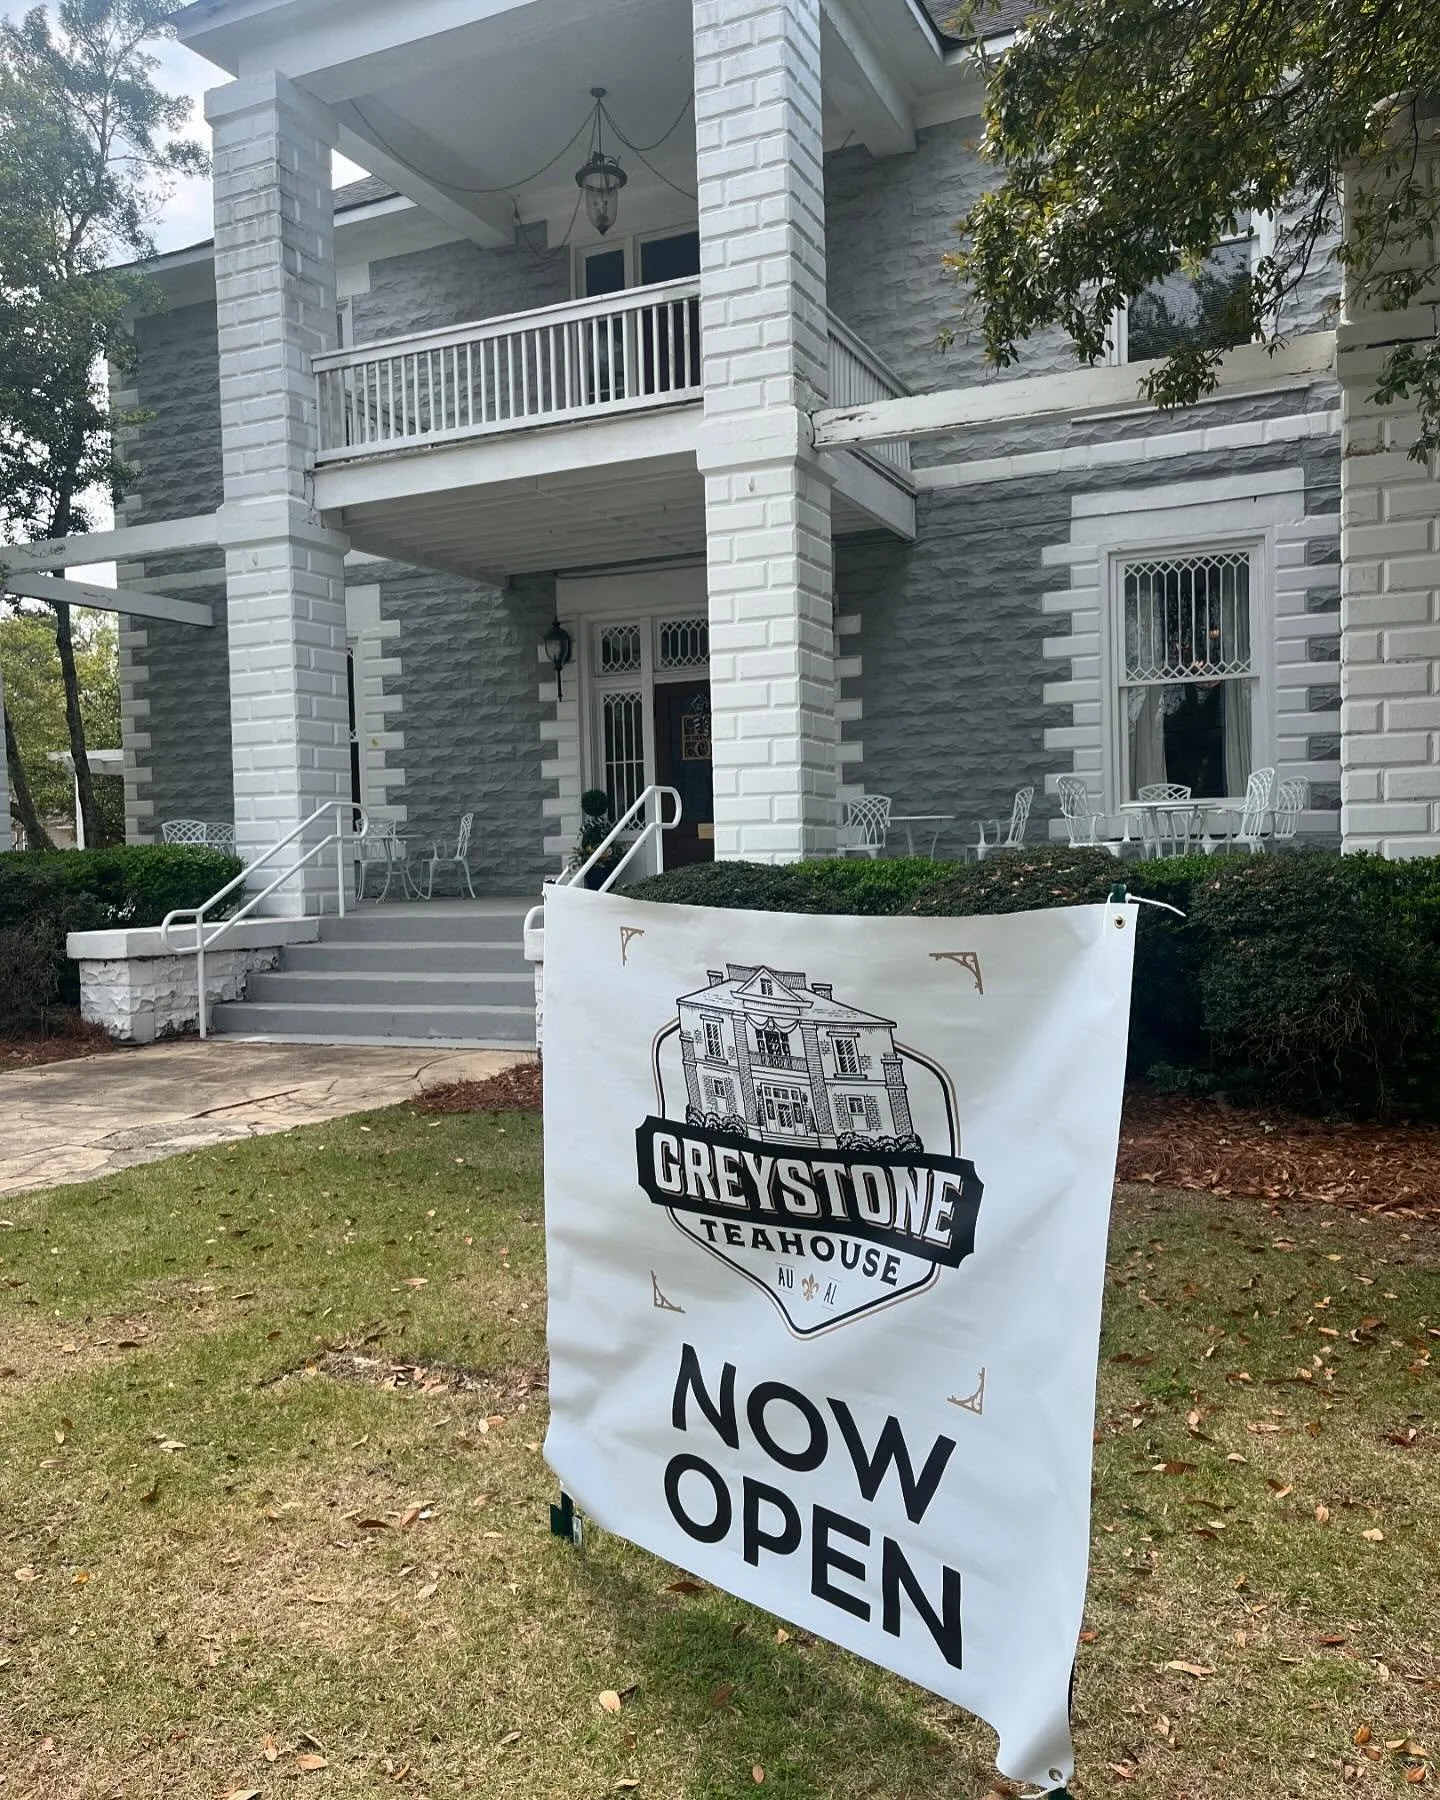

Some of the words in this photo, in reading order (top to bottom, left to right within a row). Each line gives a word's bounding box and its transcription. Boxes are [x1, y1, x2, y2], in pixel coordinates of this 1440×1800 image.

[652, 1131, 964, 1248] GREYSTONE
[700, 1218, 901, 1286] TEAHOUSE
[778, 1266, 794, 1289] AU
[823, 1281, 837, 1305] AL
[672, 1343, 957, 1525] NOW
[664, 1453, 963, 1671] OPEN
